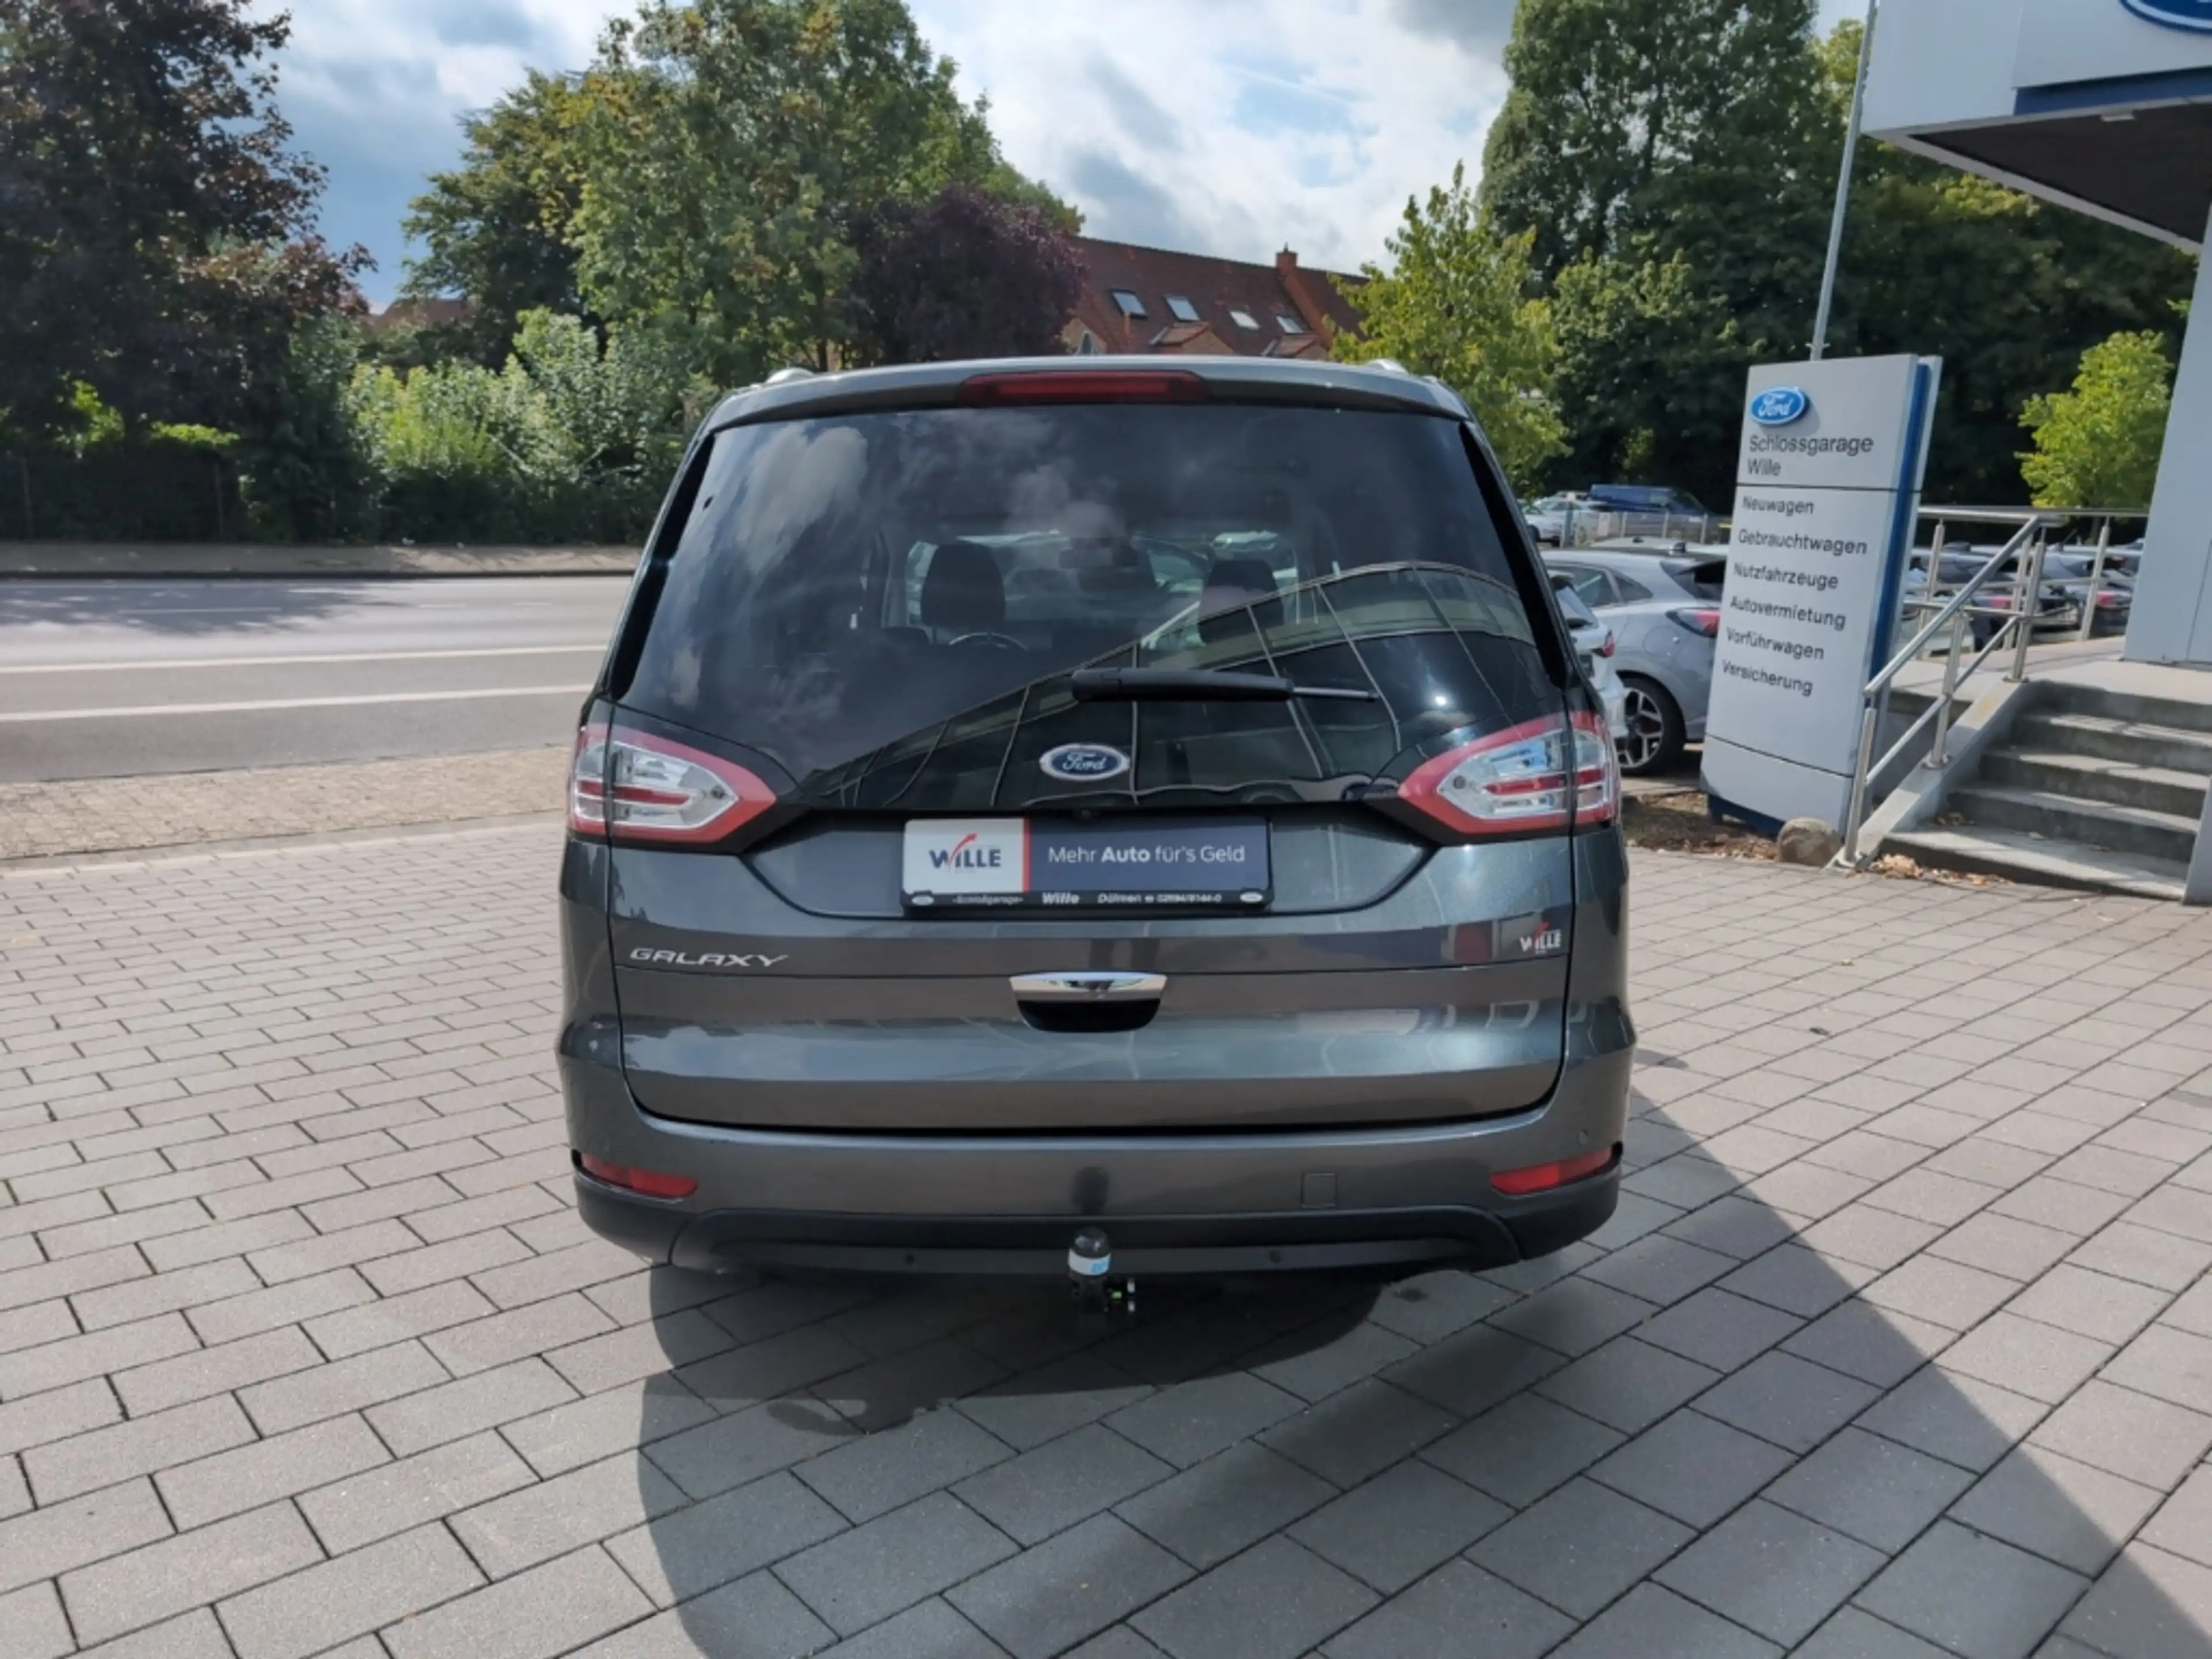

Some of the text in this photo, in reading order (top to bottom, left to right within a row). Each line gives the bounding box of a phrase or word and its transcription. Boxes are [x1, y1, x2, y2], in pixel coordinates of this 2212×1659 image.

[1758, 393, 1794, 417] Ford
[1749, 434, 1874, 456] Schlossgarage
[1748, 459, 1781, 476] Wille
[1743, 496, 1815, 517] Neuwagen
[1738, 528, 1868, 556] Gebrauchtwagen
[1734, 562, 1839, 591] Nutzfahrzeuge
[1730, 596, 1847, 631] Autovermietung
[1726, 626, 1824, 660] Vorführwagen
[1722, 659, 1813, 697] Versicherung
[1062, 752, 1107, 771] Ford
[1048, 845, 1245, 863] Mehr Auto für's Geld
[630, 948, 789, 967] GALAXY
